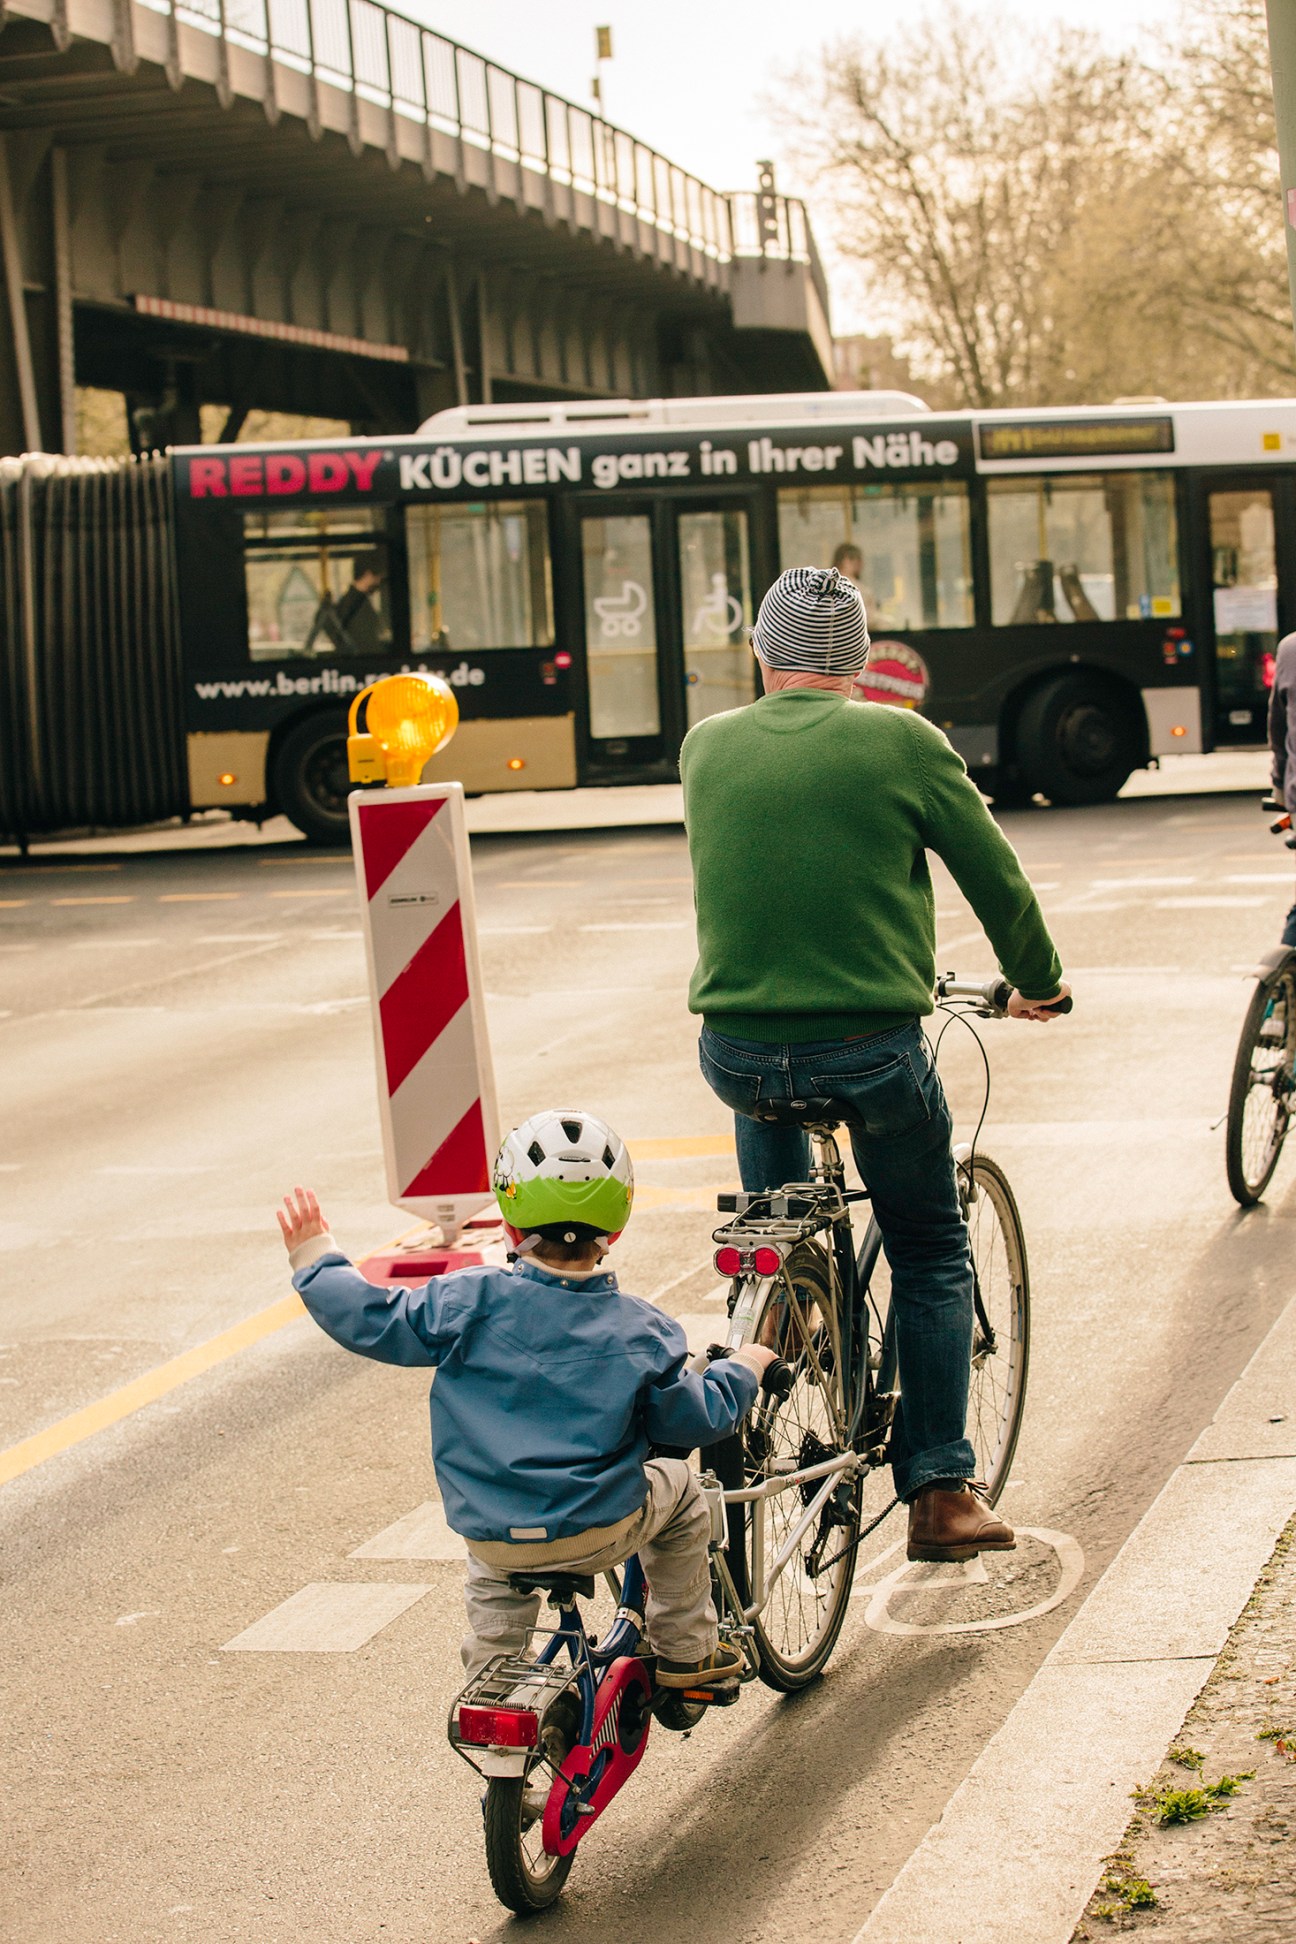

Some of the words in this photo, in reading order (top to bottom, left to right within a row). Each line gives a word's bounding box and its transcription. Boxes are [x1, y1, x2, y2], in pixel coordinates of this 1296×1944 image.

[189, 451, 383, 498] REDDY
[400, 446, 582, 490] KÜCHEN
[591, 451, 691, 489] ganz
[700, 440, 738, 476] in
[747, 437, 843, 474] Ihrer
[852, 430, 959, 470] Nähe
